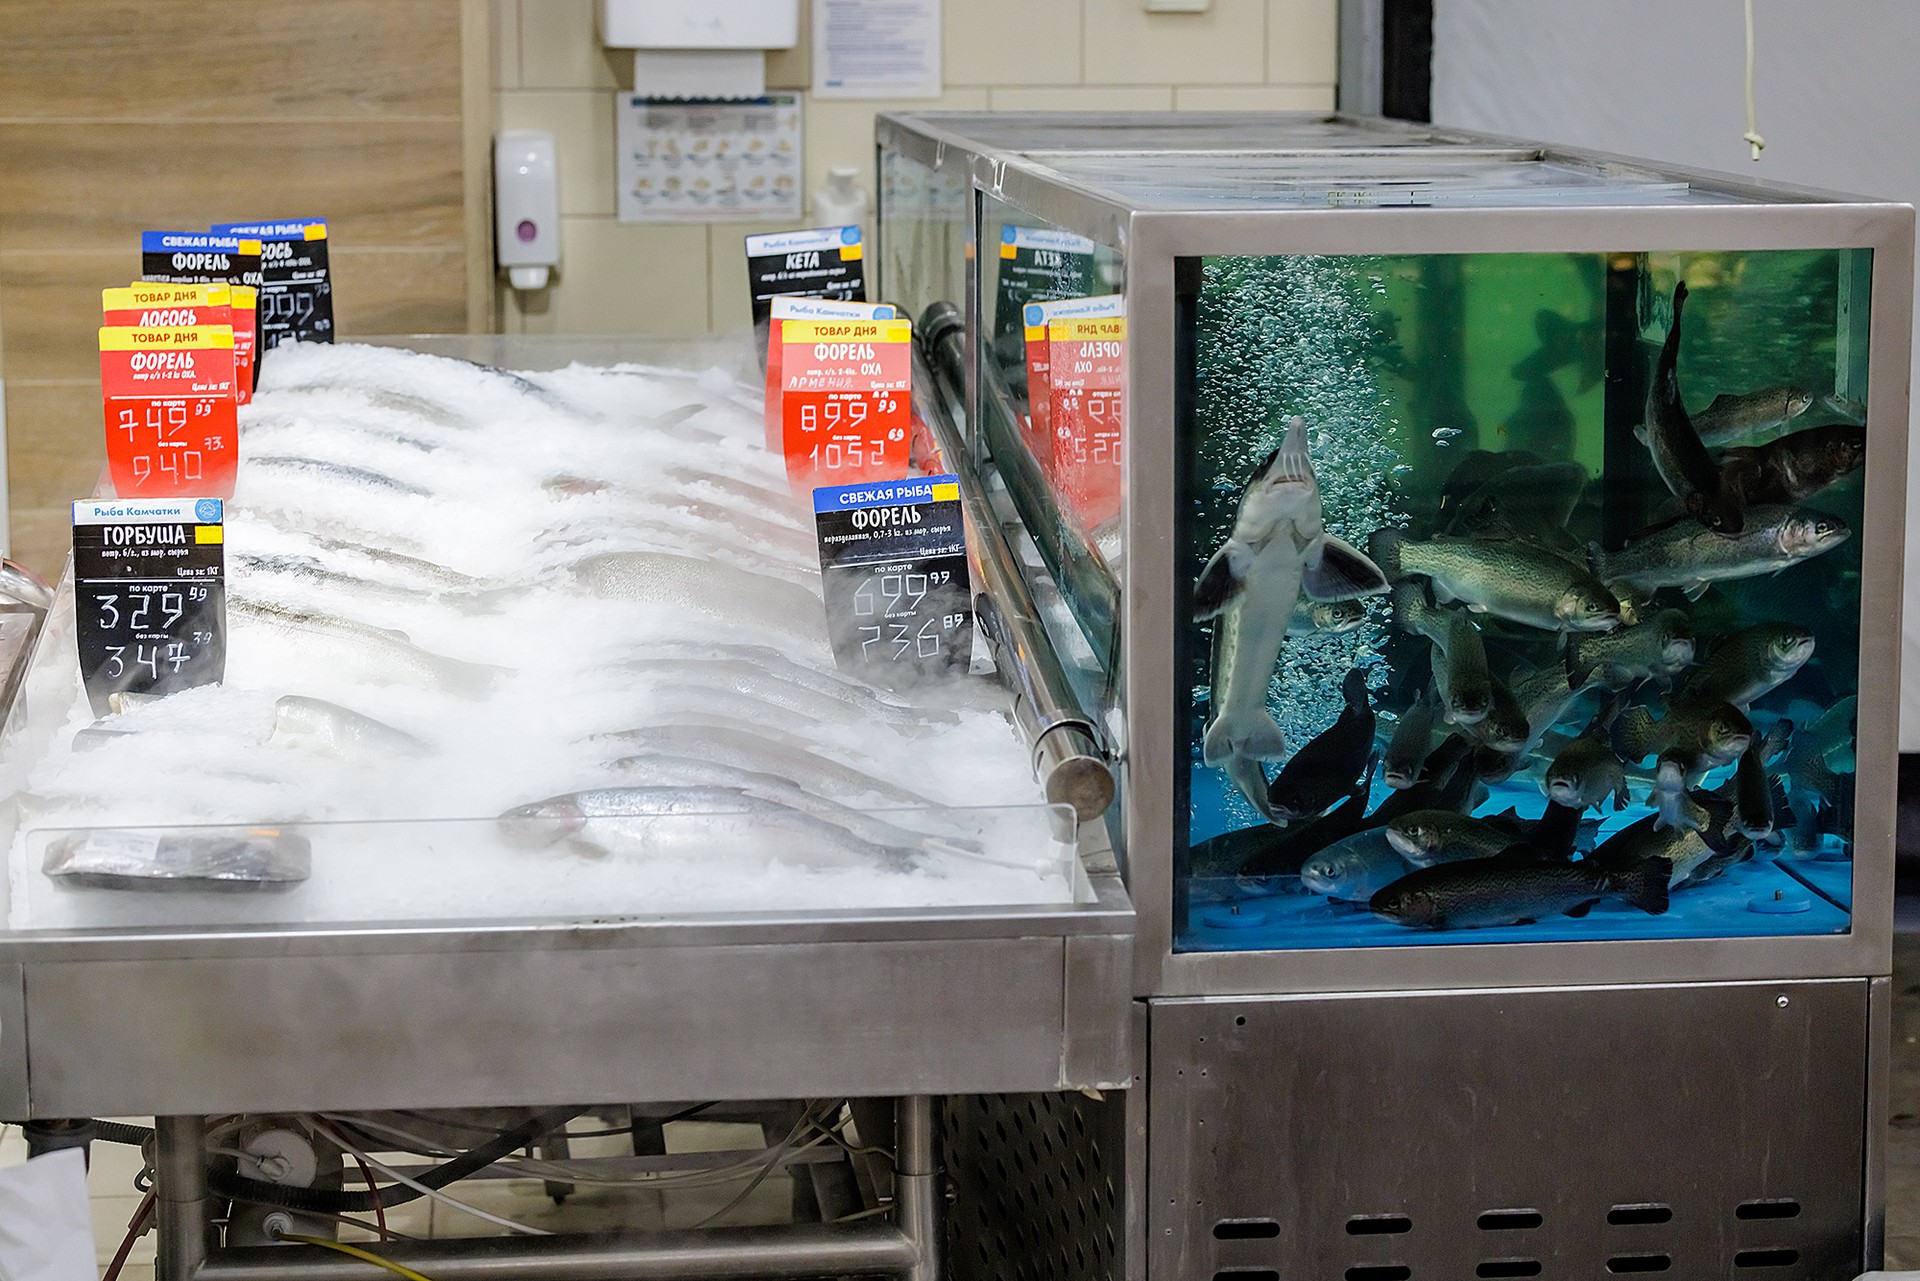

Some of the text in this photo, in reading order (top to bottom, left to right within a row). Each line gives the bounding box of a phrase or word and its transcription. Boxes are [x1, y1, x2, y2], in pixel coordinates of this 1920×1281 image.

[275, 223, 304, 236] РЫБА
[162, 236, 238, 248] СВЕЖАЯ РЫБА
[171, 252, 231, 271] ФОРЕЛЬ
[786, 251, 820, 270] КЕТА
[133, 291, 197, 303] ТОВАР ДНЯ
[139, 309, 197, 327] ЛОСОСЬ
[789, 305, 861, 318] Рыба Камчатки
[131, 332, 198, 343] ТОВАР ДНЯ
[814, 326, 877, 337] ТОВАР ДНЯ
[813, 342, 876, 361] ФОРЕЛЬ
[130, 351, 195, 371] ФОРЕЛЬ
[860, 362, 882, 376] ОХЛ
[839, 393, 862, 401] карте
[162, 400, 187, 409] карте
[801, 402, 868, 433] 899
[119, 407, 187, 443] 749
[888, 428, 904, 442] 69
[809, 440, 884, 472] 1052
[133, 450, 202, 488] 940
[839, 488, 894, 504] СВЕЖАЯ
[896, 485, 933, 498] РЫБА
[94, 507, 181, 517] Рыба Камчатки
[851, 505, 922, 530] ФОРЕЛЬ
[103, 525, 187, 546] ГОРБУША
[873, 530, 893, 540] 0,7-3
[930, 525, 951, 535] сырья
[167, 548, 189, 558] сырья
[919, 547, 937, 556] Цена
[948, 544, 960, 553] 1КГ
[177, 567, 194, 577] Цена
[206, 566, 219, 575] 1КГ
[874, 563, 913, 574] по карте
[142, 584, 168, 594] карте
[854, 570, 950, 616] 699 99
[96, 586, 208, 629] 329 99
[896, 610, 917, 618] карты
[148, 633, 169, 641] карты
[858, 618, 939, 662] 736
[105, 642, 191, 680] 347
